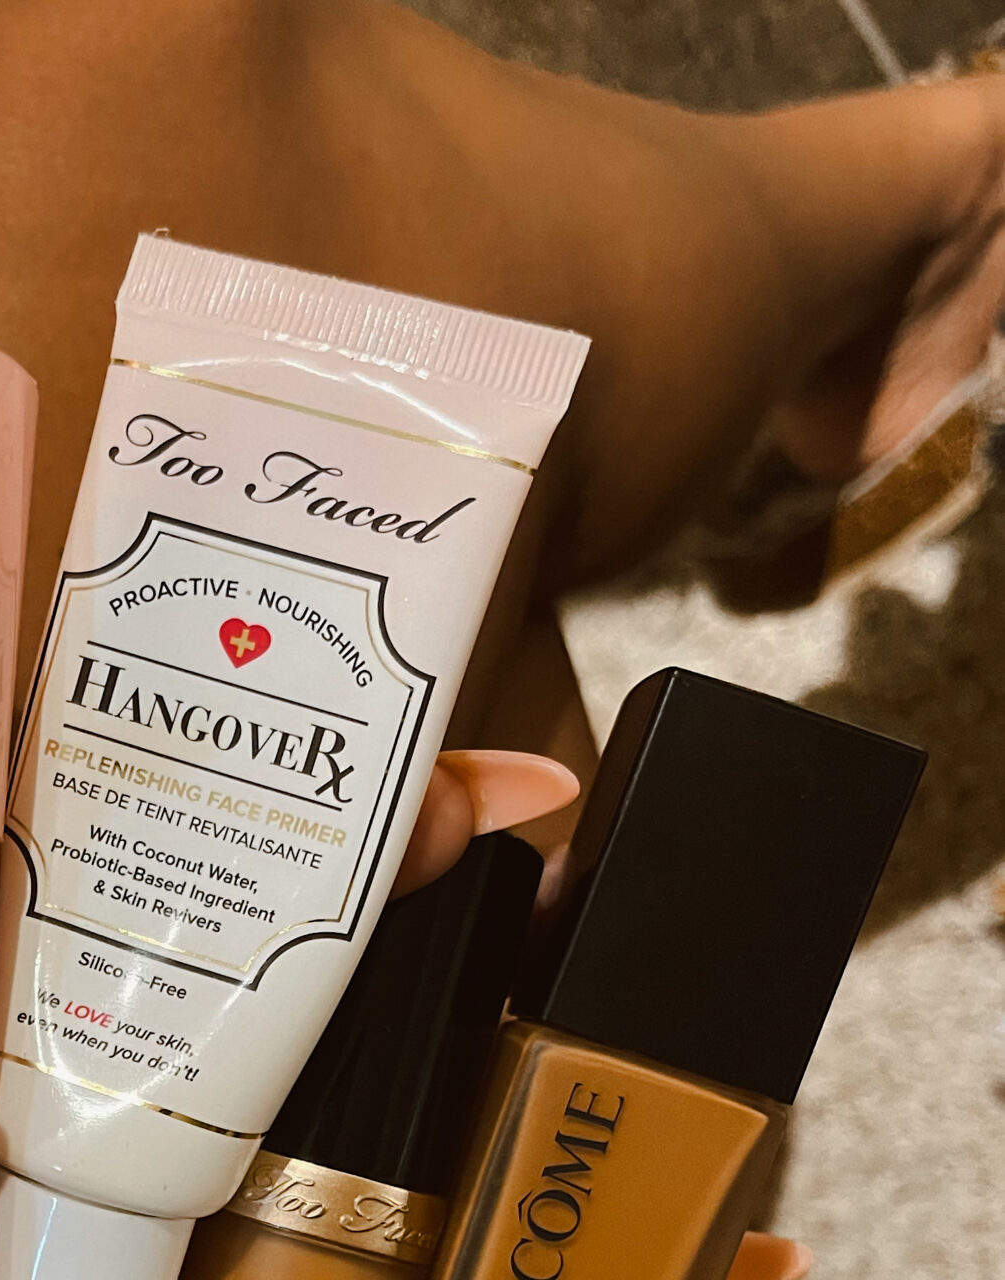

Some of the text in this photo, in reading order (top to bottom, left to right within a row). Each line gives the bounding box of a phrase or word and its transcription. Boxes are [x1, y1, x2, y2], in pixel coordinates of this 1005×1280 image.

[108, 413, 477, 544] Too Faced
[109, 577, 373, 688] PROACTIVE NOURISHING
[44, 738, 348, 848] REPLENISHING FACE PRIMER
[52, 772, 324, 870] BASE DE TEINT REVITALISANTE
[50, 838, 276, 924] Probiotic-Based Ingredient
[90, 825, 258, 894] With Coconut Water,
[93, 879, 222, 933] & Skin Revivers
[78, 951, 187, 1000] Silico-Free
[17, 1010, 57, 1034] even
[62, 1025, 109, 1052] when
[109, 1042, 144, 1065] you
[63, 1000, 114, 1029] LOVE
[113, 1018, 155, 1043] your
[156, 1031, 194, 1058] skin,
[242, 1166, 328, 1219] Too
